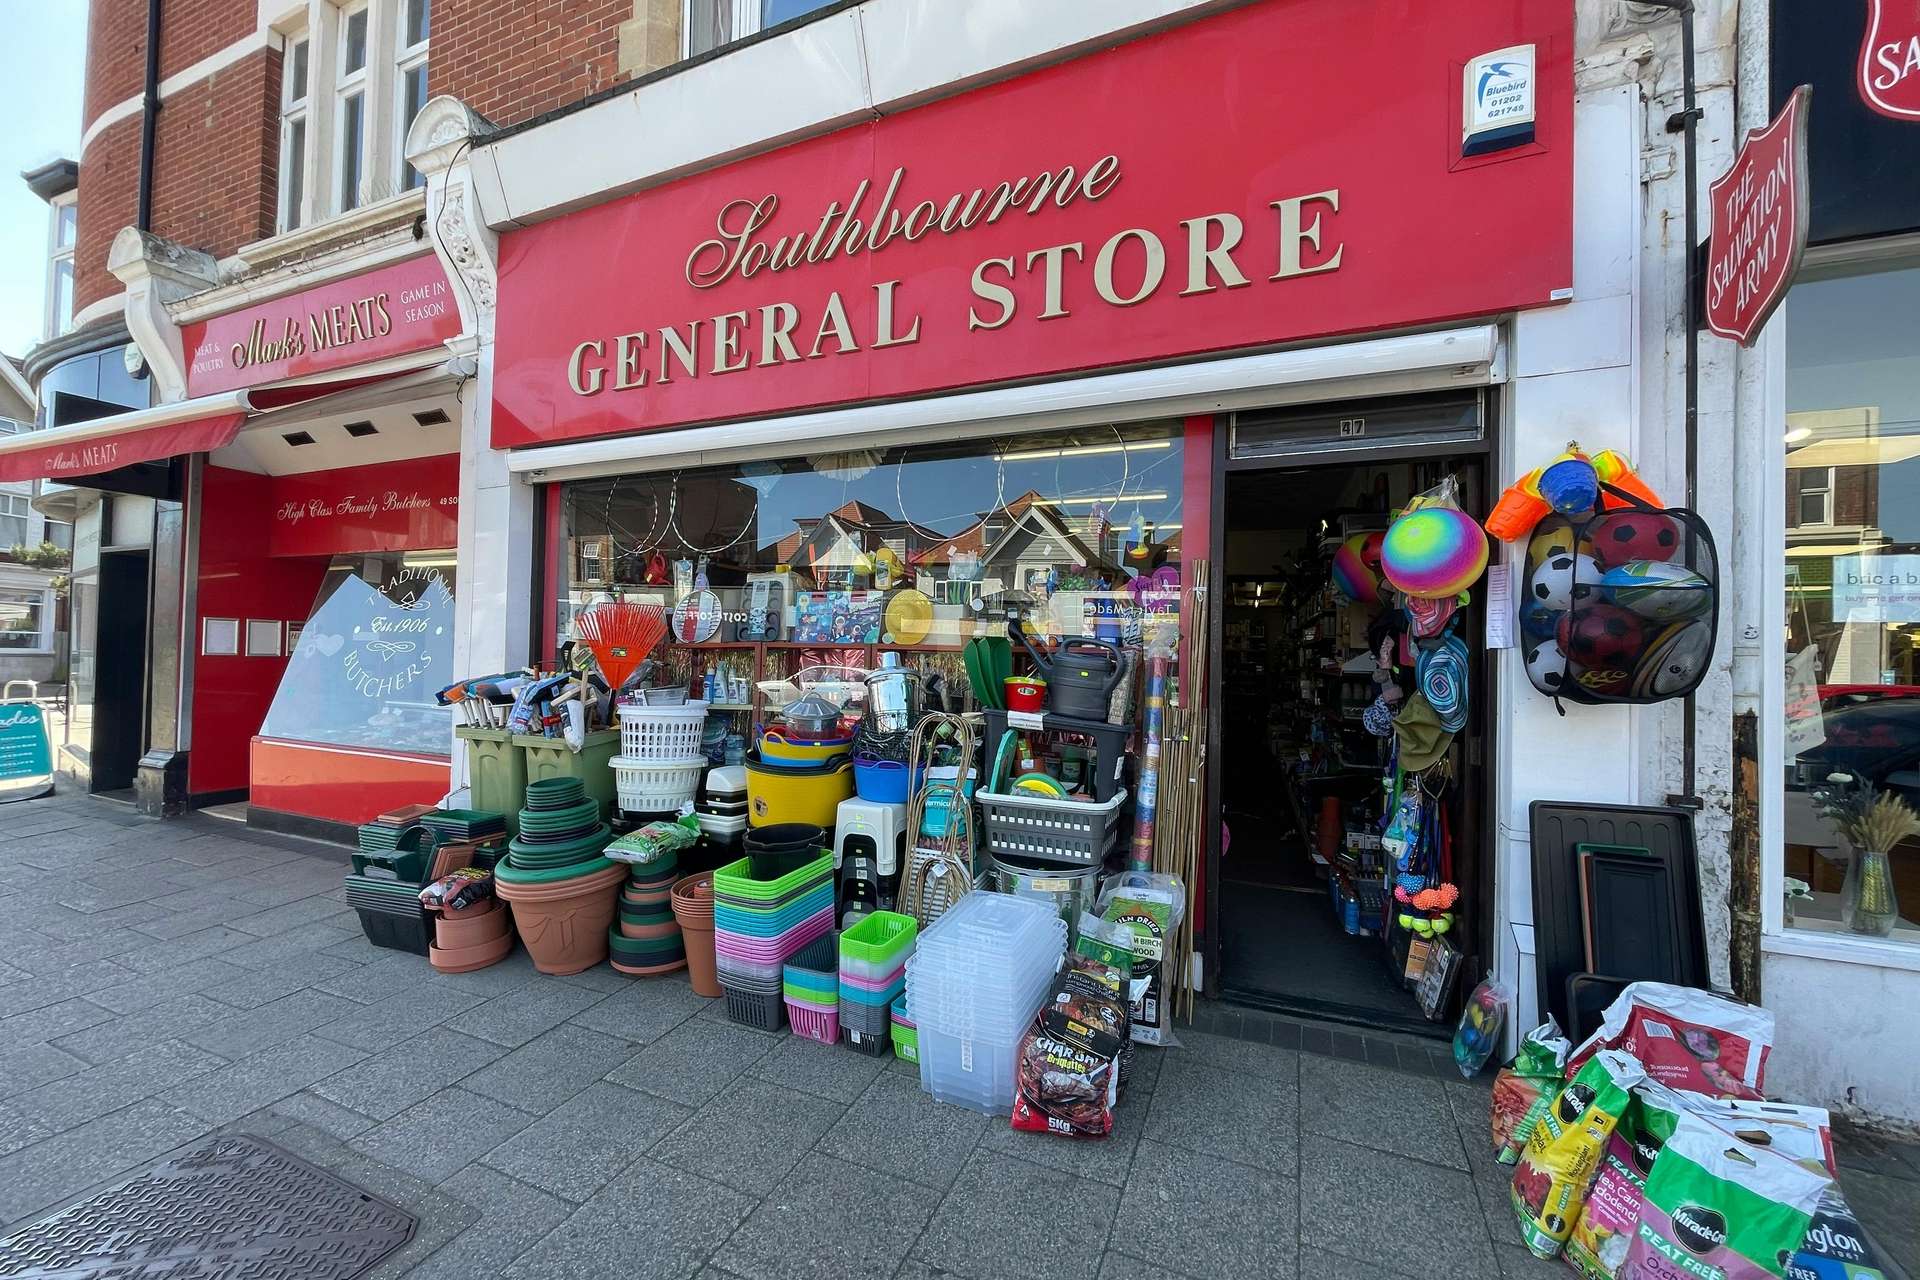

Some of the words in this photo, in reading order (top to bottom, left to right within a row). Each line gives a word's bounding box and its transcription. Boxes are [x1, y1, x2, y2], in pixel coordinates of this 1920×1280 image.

[1486, 80, 1527, 96] Bluebird
[1488, 105, 1525, 118] 621749
[1491, 95, 1522, 106] 01202
[1726, 159, 1754, 235] THE
[685, 153, 1122, 290] Southbourne
[1711, 136, 1788, 311] SALVATION
[1734, 205, 1782, 323] ARMY
[400, 286, 431, 304] GAME
[433, 280, 446, 296] IN
[567, 278, 921, 396] GENERAL
[968, 188, 1344, 332] STORE
[405, 301, 445, 323] SEASON
[231, 317, 306, 370] Mark's
[309, 293, 393, 353] MEATS
[195, 343, 213, 357] MEAT
[191, 358, 224, 374] POULTRY
[1342, 420, 1363, 435] 47
[82, 443, 118, 467] MEATS
[277, 502, 305, 526] High
[308, 499, 333, 518] Class
[336, 496, 379, 519] Family
[382, 491, 432, 511] Butchers
[366, 566, 456, 608] TRADITIONAL
[1847, 573, 1883, 584] bric
[1889, 575, 1899, 584] a
[344, 650, 432, 697] BUTCHERS
[1137, 916, 1160, 933] DRIED
[1140, 938, 1162, 948] BIRCH
[1046, 1053, 1086, 1074] Briquettes
[1048, 1117, 1070, 1132] 5Kg
[1607, 1155, 1637, 1183] PEAT
[1640, 1225, 1684, 1260] PEAT
[1682, 1257, 1721, 1280] FREE
